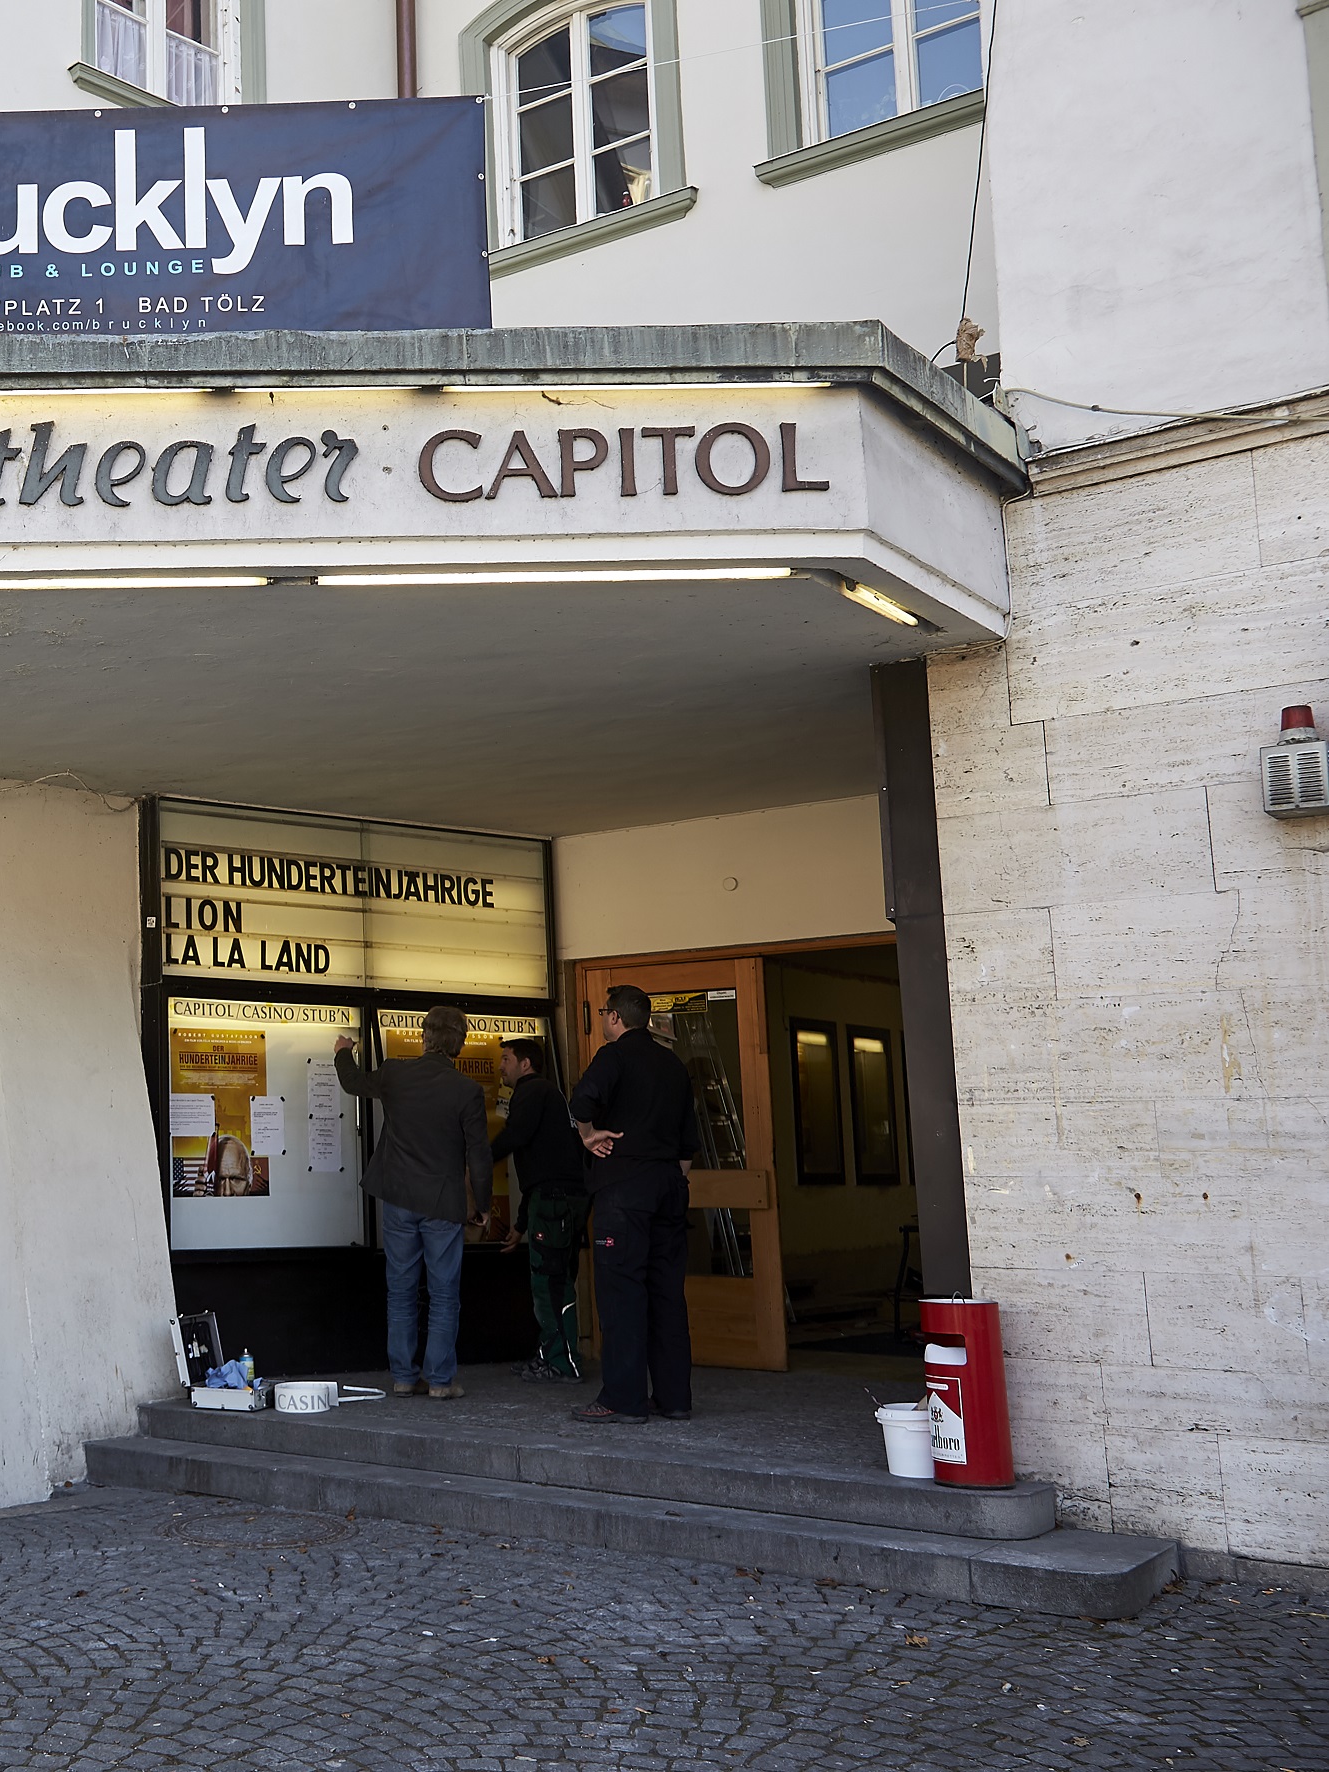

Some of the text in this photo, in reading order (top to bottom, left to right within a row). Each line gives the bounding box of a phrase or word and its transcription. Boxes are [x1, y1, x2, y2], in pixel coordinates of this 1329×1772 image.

[45, 264, 60, 279] &
[81, 259, 205, 278] LOUNGE
[95, 298, 105, 314] 1
[138, 296, 188, 313] BAD
[201, 293, 266, 313] TÖLZ
[418, 421, 830, 504] CAPITOL
[164, 846, 495, 909] DER HUNDERTEINJÄHRIGE
[165, 895, 243, 934] LION
[165, 934, 331, 974] LA LA LAND
[277, 1393, 329, 1411] CASIN
